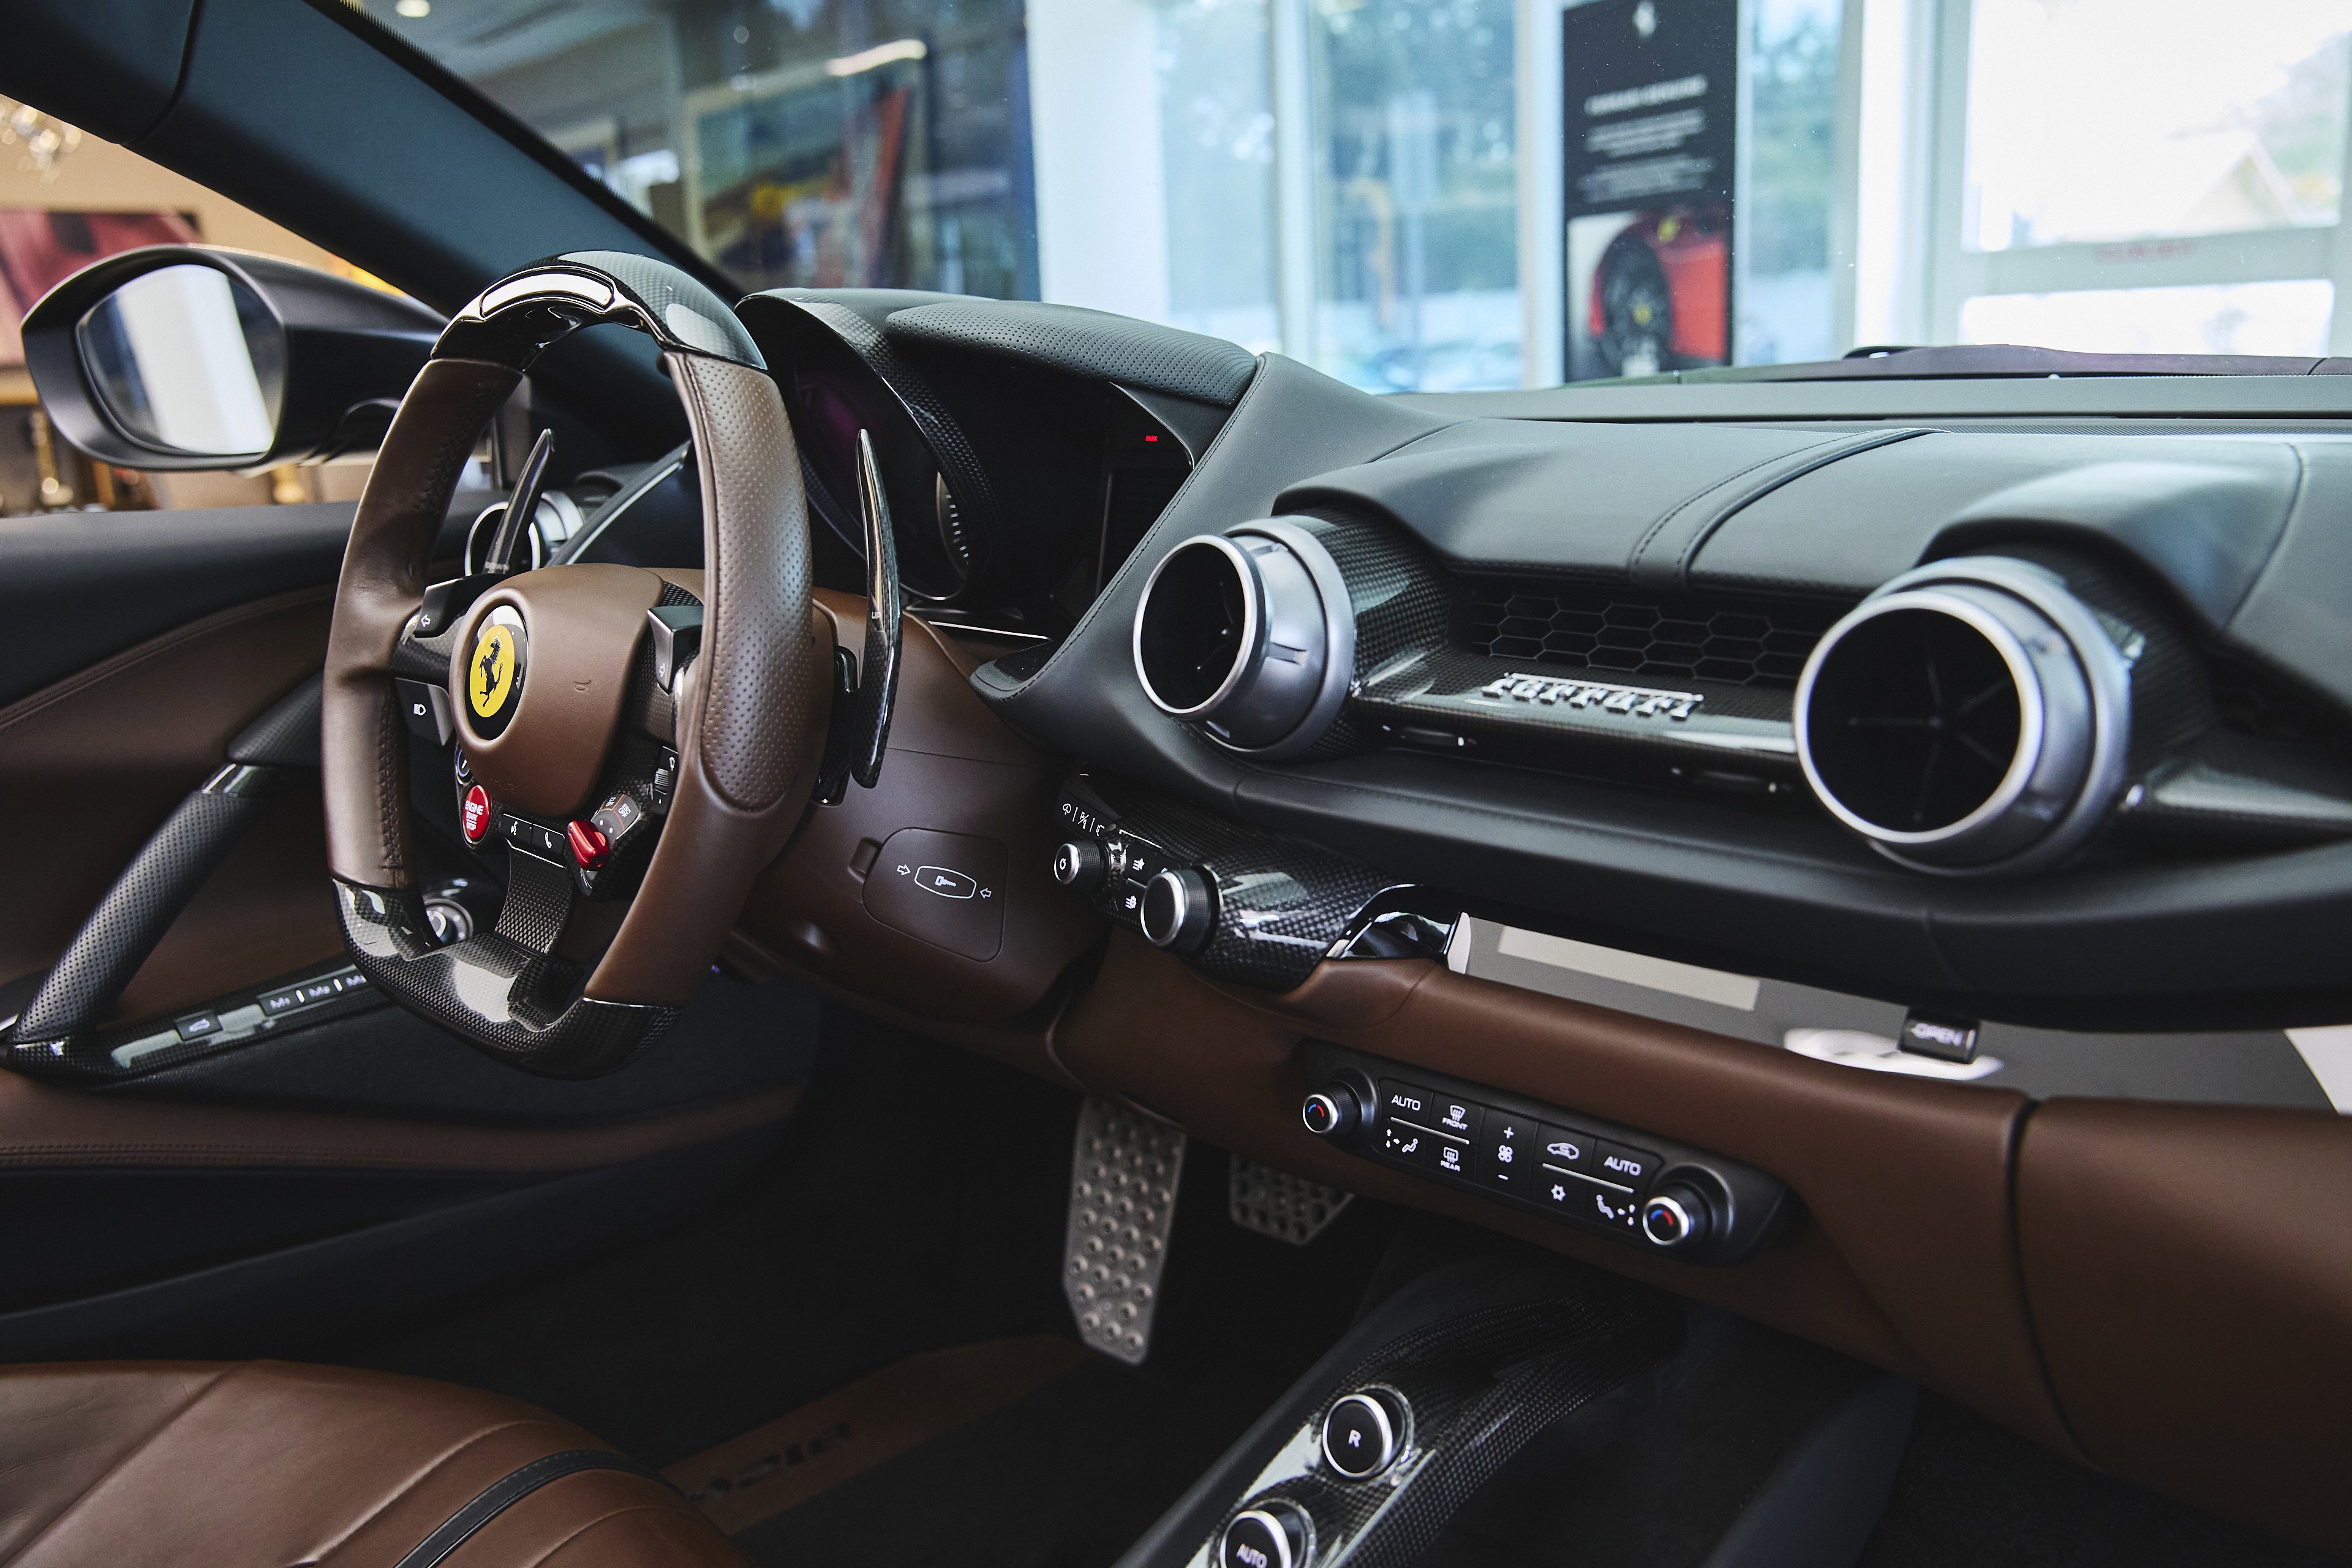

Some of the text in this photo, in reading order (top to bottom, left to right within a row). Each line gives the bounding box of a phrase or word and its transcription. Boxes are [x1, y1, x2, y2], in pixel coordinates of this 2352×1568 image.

[871, 611, 882, 620] UP
[465, 800, 484, 816] ENGINE
[618, 807, 628, 818] OFF
[622, 803, 631, 815] ESC
[466, 811, 478, 821] START
[466, 821, 477, 831] STOP
[1391, 1095, 1421, 1111] AUTO
[1442, 1117, 1468, 1130] FRONT
[1440, 1159, 1461, 1172] REAR
[1604, 1156, 1642, 1176] AUTO
[1348, 1429, 1362, 1448] R
[1236, 1543, 1268, 1568] AUTO
